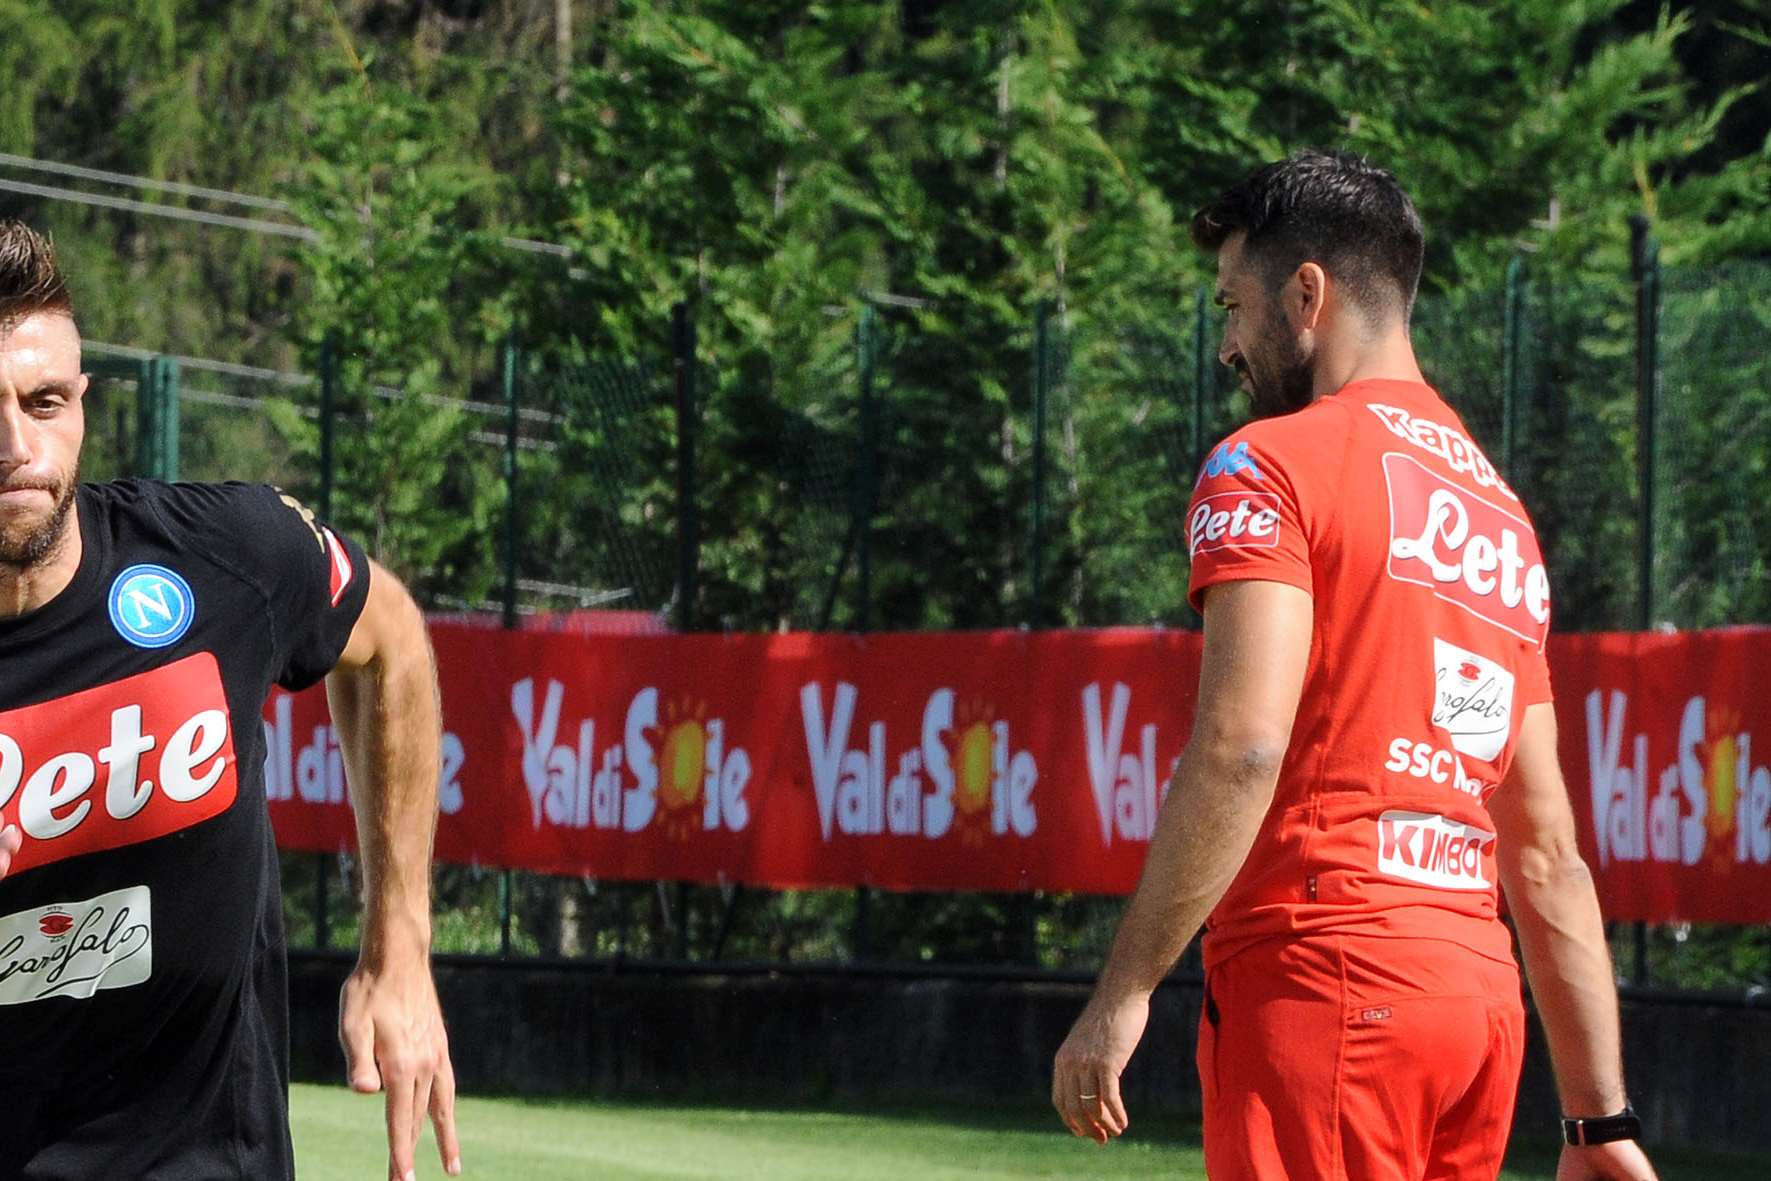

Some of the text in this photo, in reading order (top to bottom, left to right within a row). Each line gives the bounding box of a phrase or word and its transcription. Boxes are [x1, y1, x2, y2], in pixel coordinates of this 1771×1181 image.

[1367, 403, 1519, 502] Kapp
[1392, 489, 1551, 622] Lete
[135, 583, 174, 630] N
[1385, 738, 1452, 783] SSC
[1381, 818, 1479, 880] KIMBO
